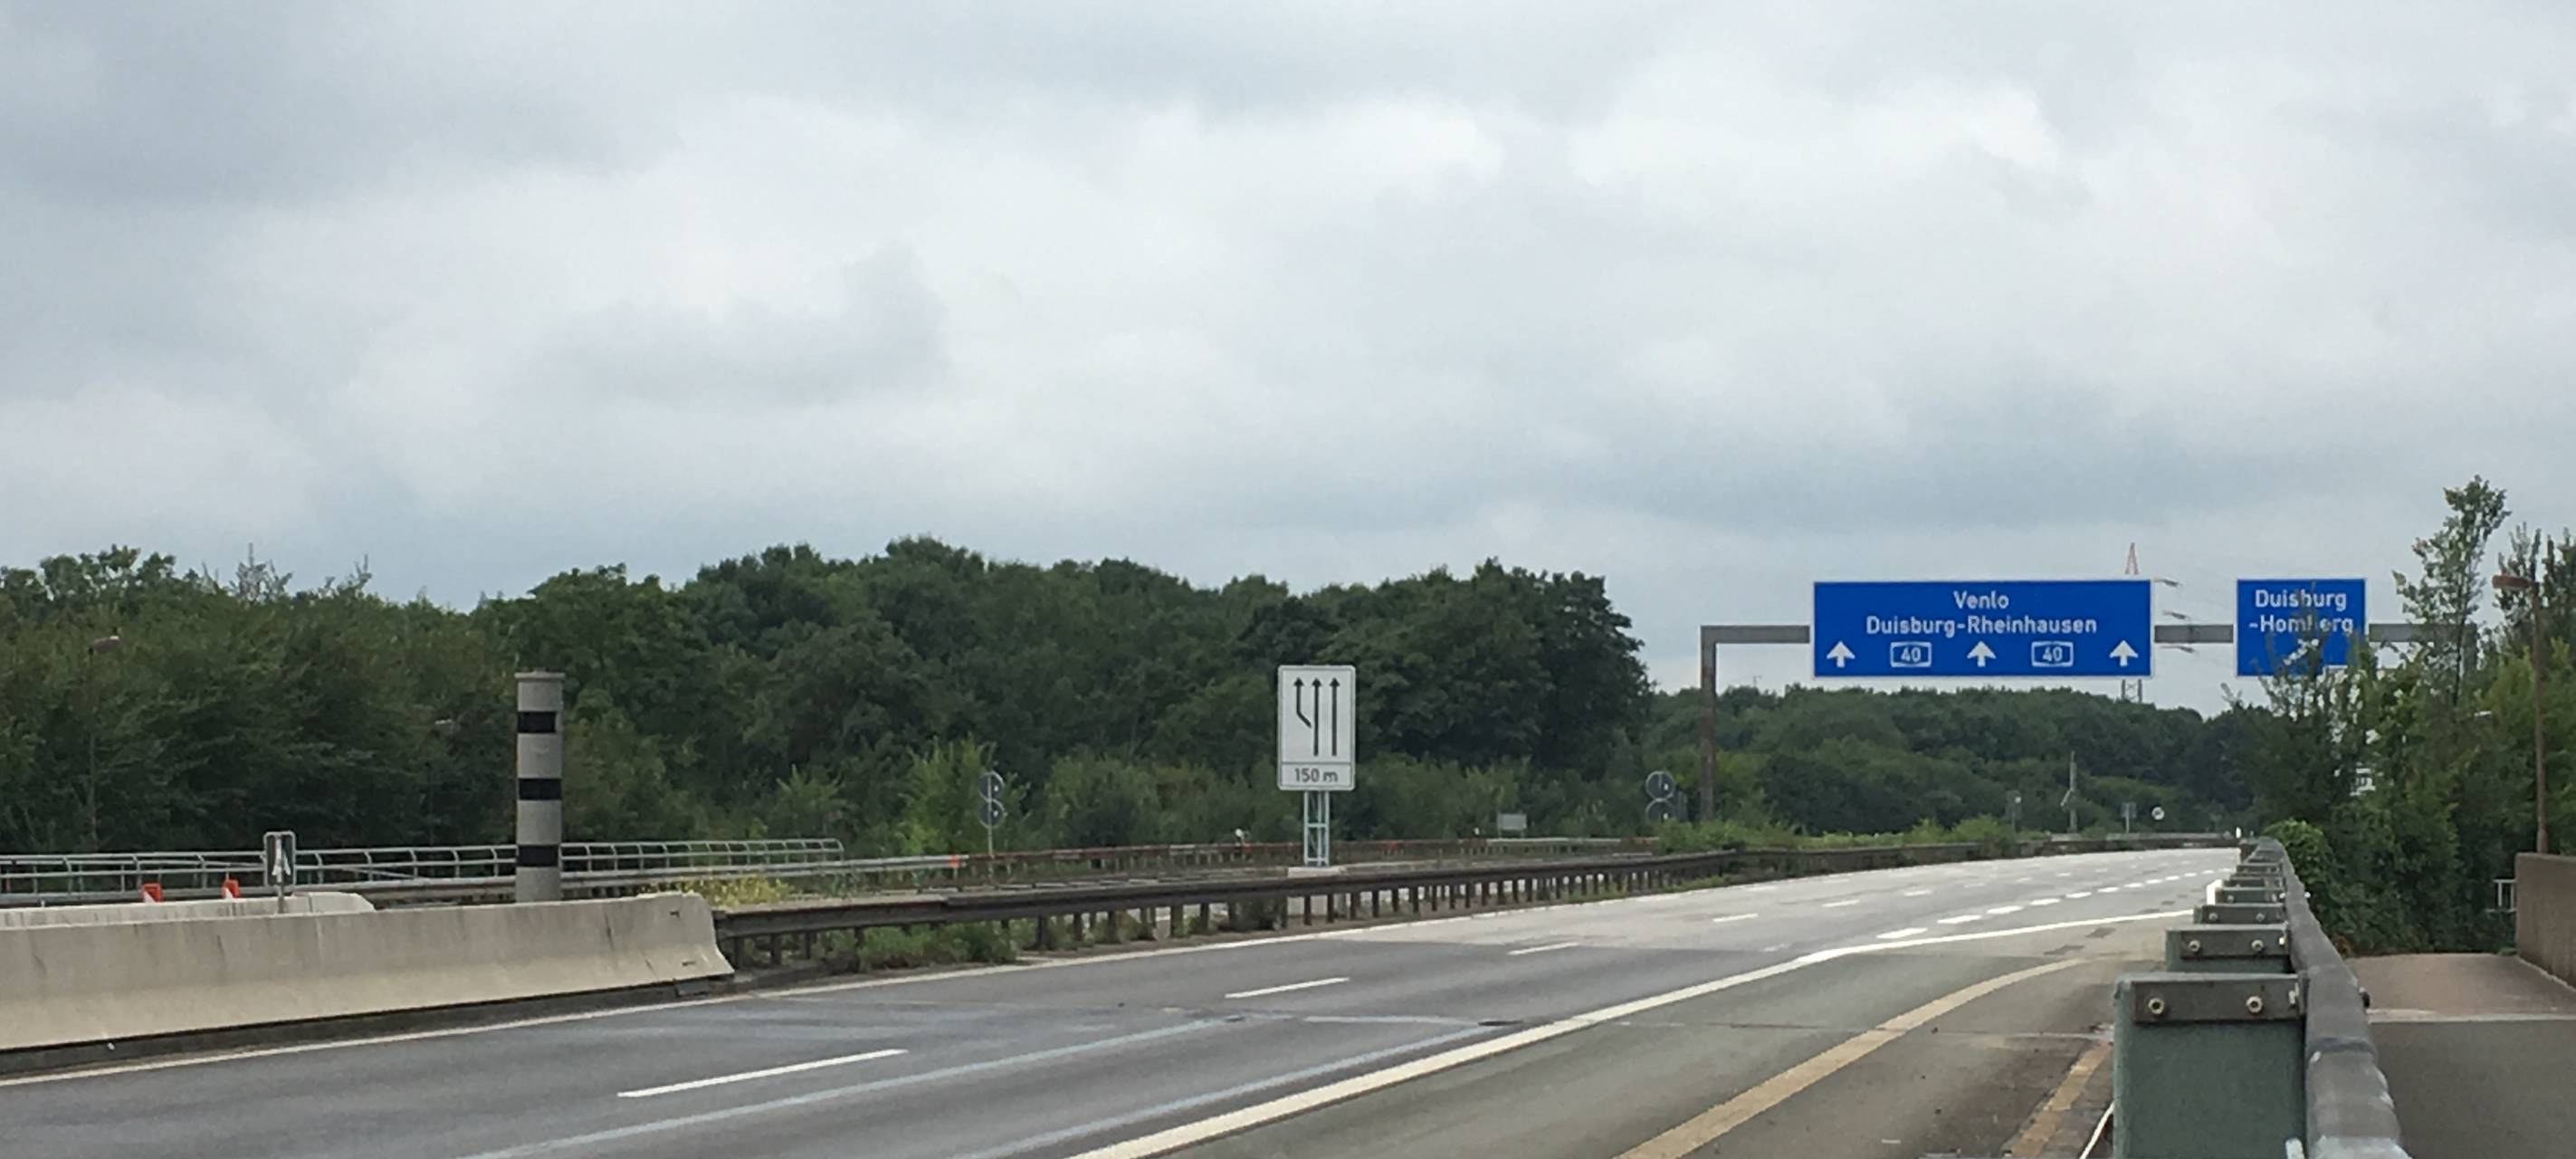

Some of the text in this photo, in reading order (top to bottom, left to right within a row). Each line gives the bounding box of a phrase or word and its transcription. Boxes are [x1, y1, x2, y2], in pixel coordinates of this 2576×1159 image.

[1953, 590, 2009, 609] Venlo
[2255, 589, 2347, 612] Duisburg
[1865, 616, 2097, 638] Duisburg-Rheinhausen
[1901, 647, 1922, 663] 40
[2042, 647, 2063, 662] 40
[1294, 768, 1339, 782] 150 m
